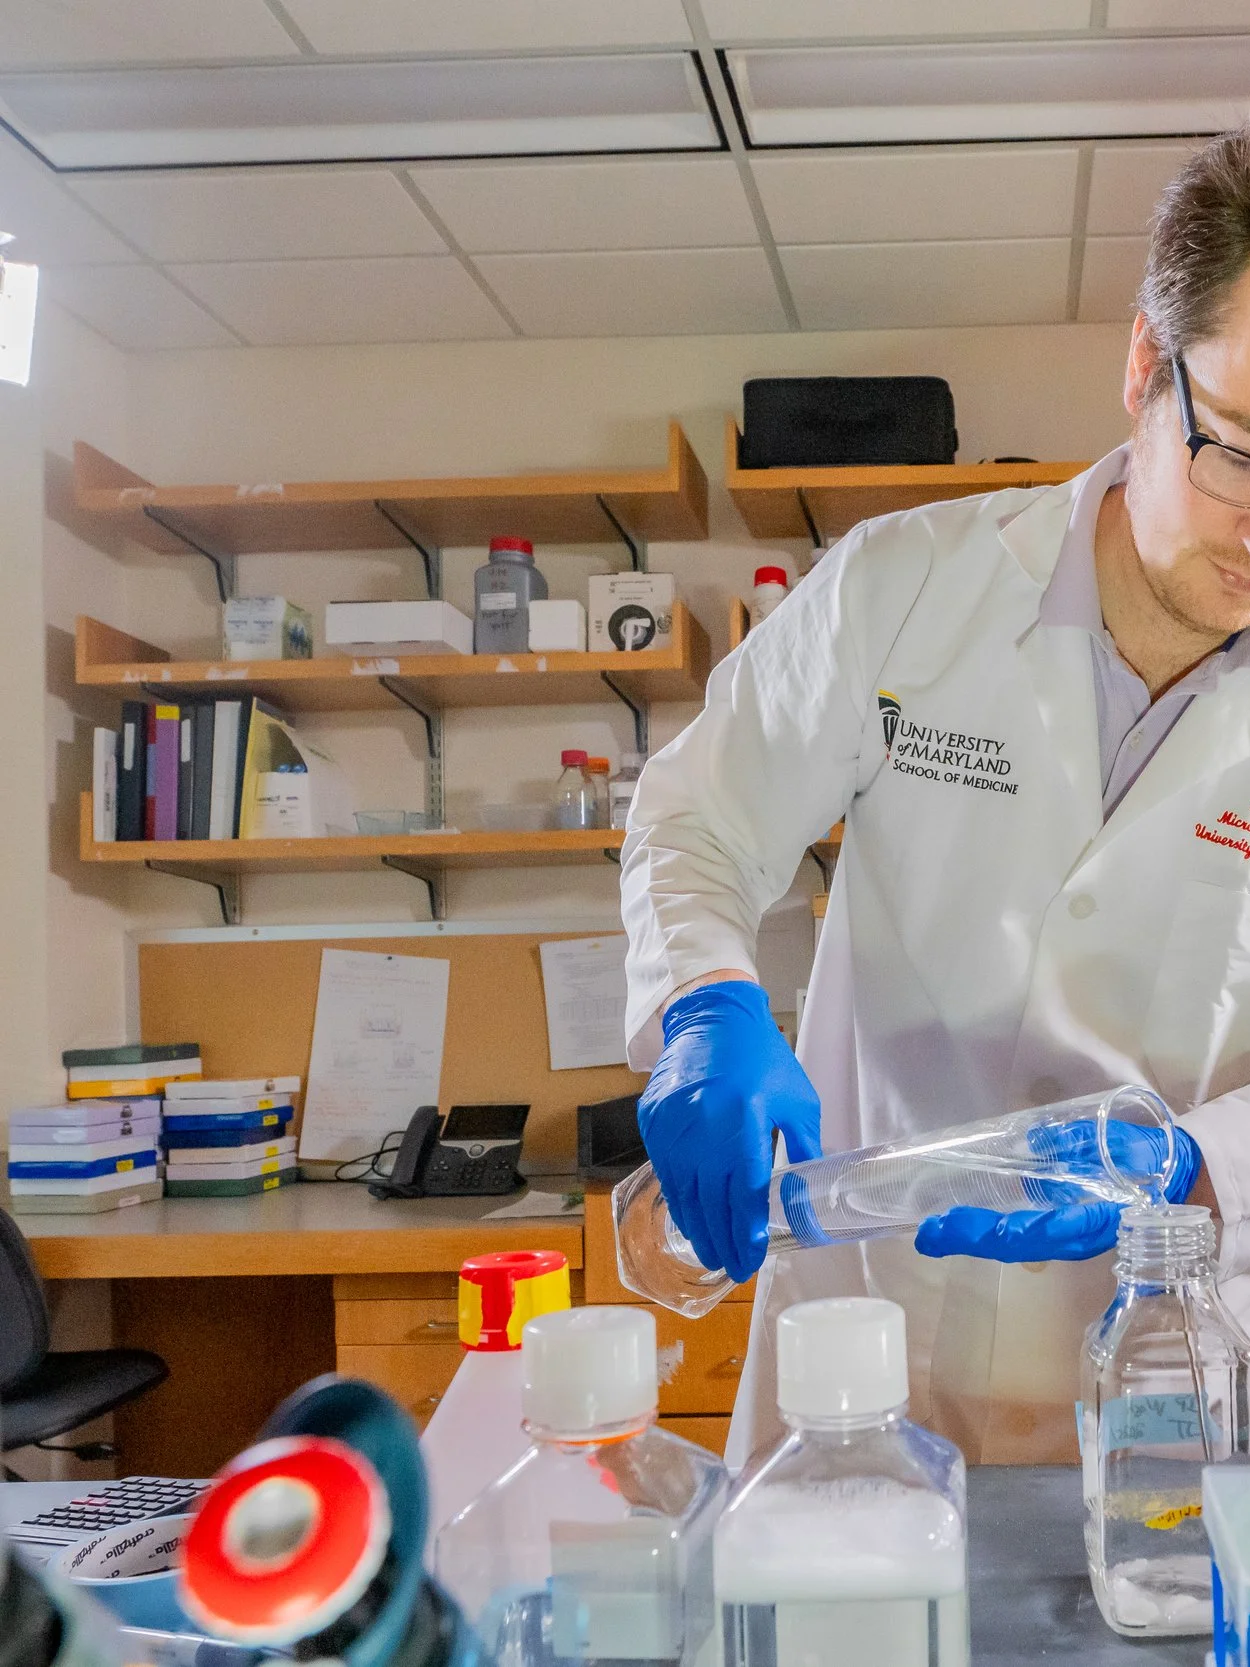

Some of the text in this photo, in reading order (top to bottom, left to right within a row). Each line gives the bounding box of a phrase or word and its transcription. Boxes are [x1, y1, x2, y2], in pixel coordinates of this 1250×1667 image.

[900, 719, 1005, 755] UNIVERSITY
[897, 742, 1011, 775] of MARYLAND
[893, 759, 1019, 795] SCHOOL OF MEDICINE
